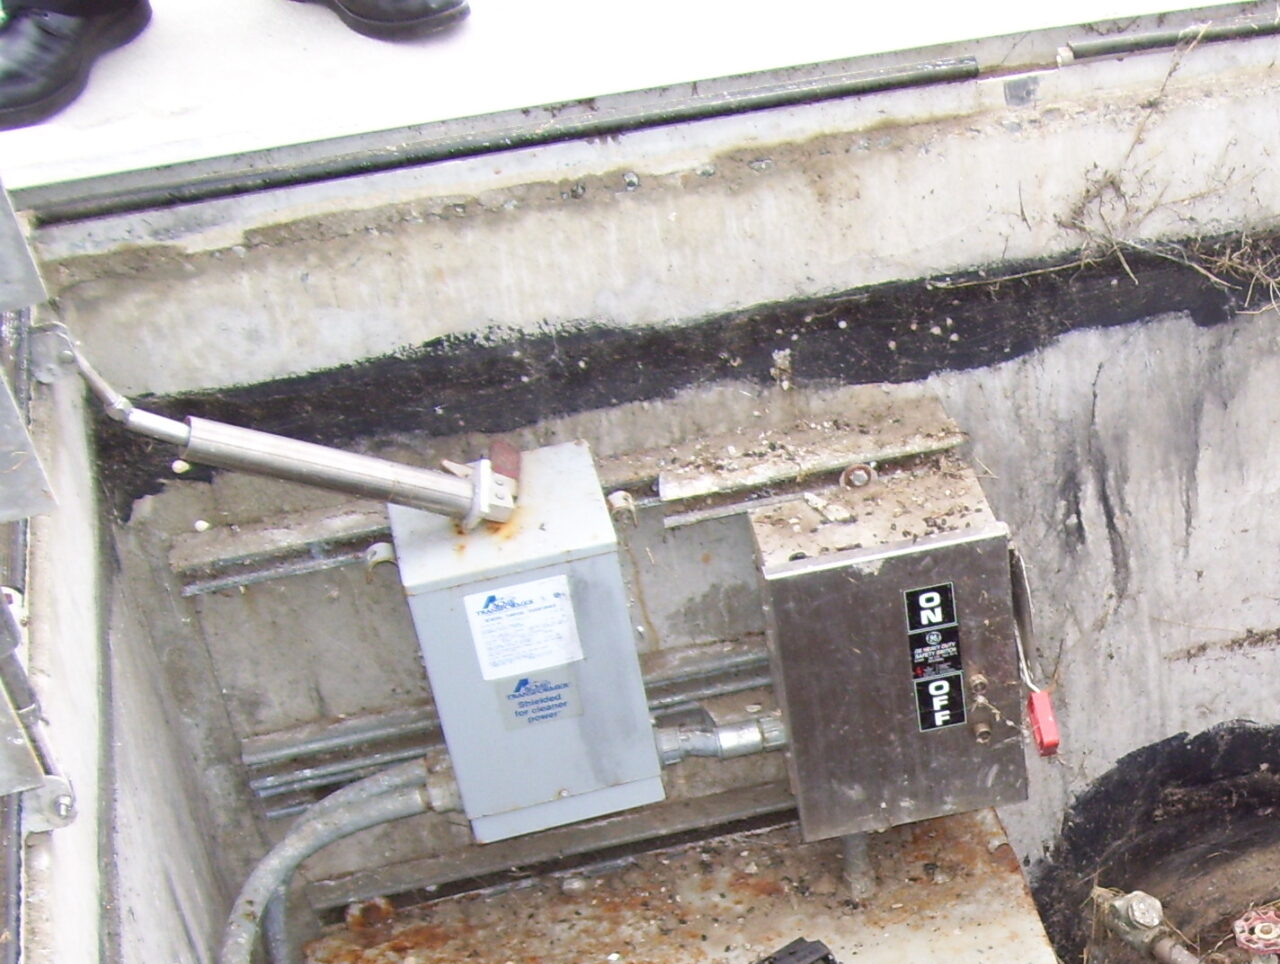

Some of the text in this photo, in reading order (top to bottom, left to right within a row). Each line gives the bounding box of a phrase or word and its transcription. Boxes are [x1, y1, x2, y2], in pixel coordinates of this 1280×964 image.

[918, 591, 943, 625] ON
[514, 700, 568, 718] for cleaner
[517, 693, 562, 709] Shielded
[928, 679, 951, 727] OFF
[527, 711, 558, 724] power
